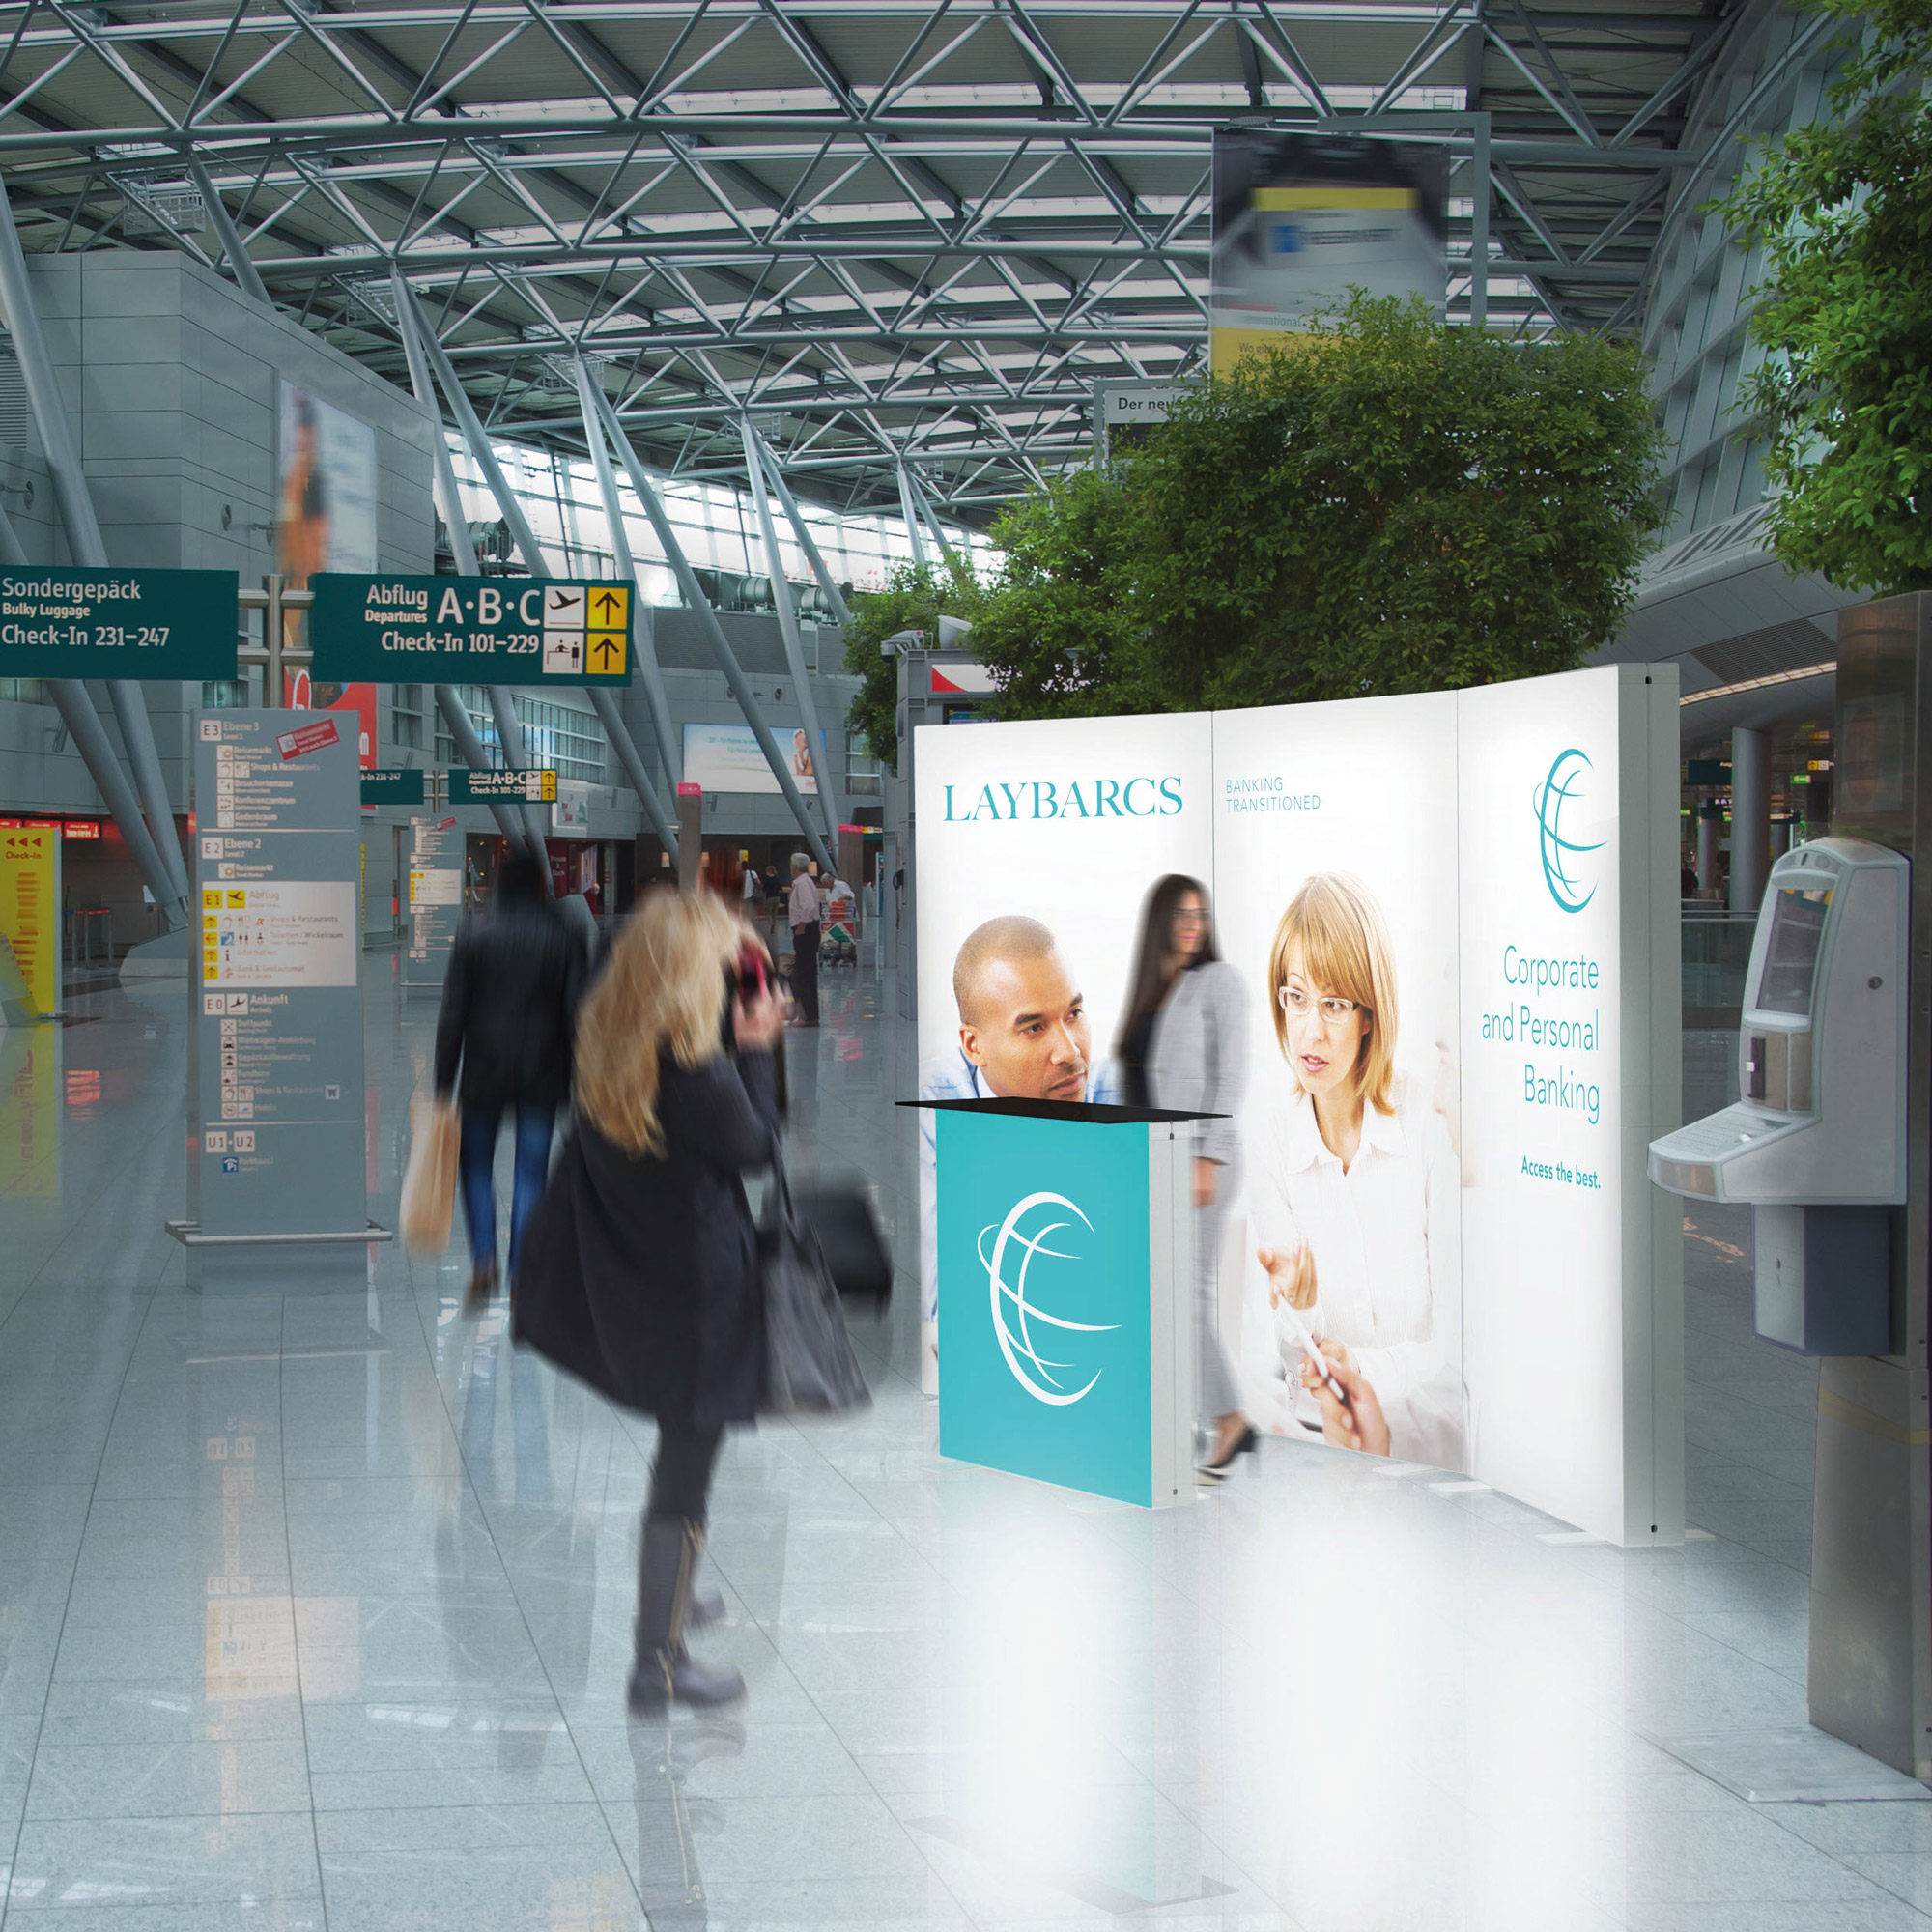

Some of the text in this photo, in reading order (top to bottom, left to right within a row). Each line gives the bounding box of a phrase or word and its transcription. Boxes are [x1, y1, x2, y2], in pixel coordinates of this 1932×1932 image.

[1238, 342, 1255, 353] Wo
[1118, 397, 1143, 410] Der
[2, 577, 142, 604] Sondergepäck
[366, 584, 428, 610] Abflug
[2, 602, 91, 619] Bulky Luggage
[364, 609, 428, 625] Departures
[1, 624, 88, 645] Check-In
[381, 631, 464, 652] Check-In
[223, 722, 252, 731] Ebene
[1226, 777, 1283, 794] BANKING
[943, 777, 1183, 821] LAYBARCS
[1226, 795, 1321, 812] TRANSITIONED
[225, 838, 253, 849] Ebene
[255, 838, 262, 849] 2
[6, 851, 42, 860] Check-In
[1504, 945, 1599, 997] Corporate
[250, 994, 288, 1005] Ankunft
[1482, 1002, 1599, 1051] and Personal
[1524, 1064, 1600, 1124] Banking
[1521, 1155, 1601, 1189] Access the best.
